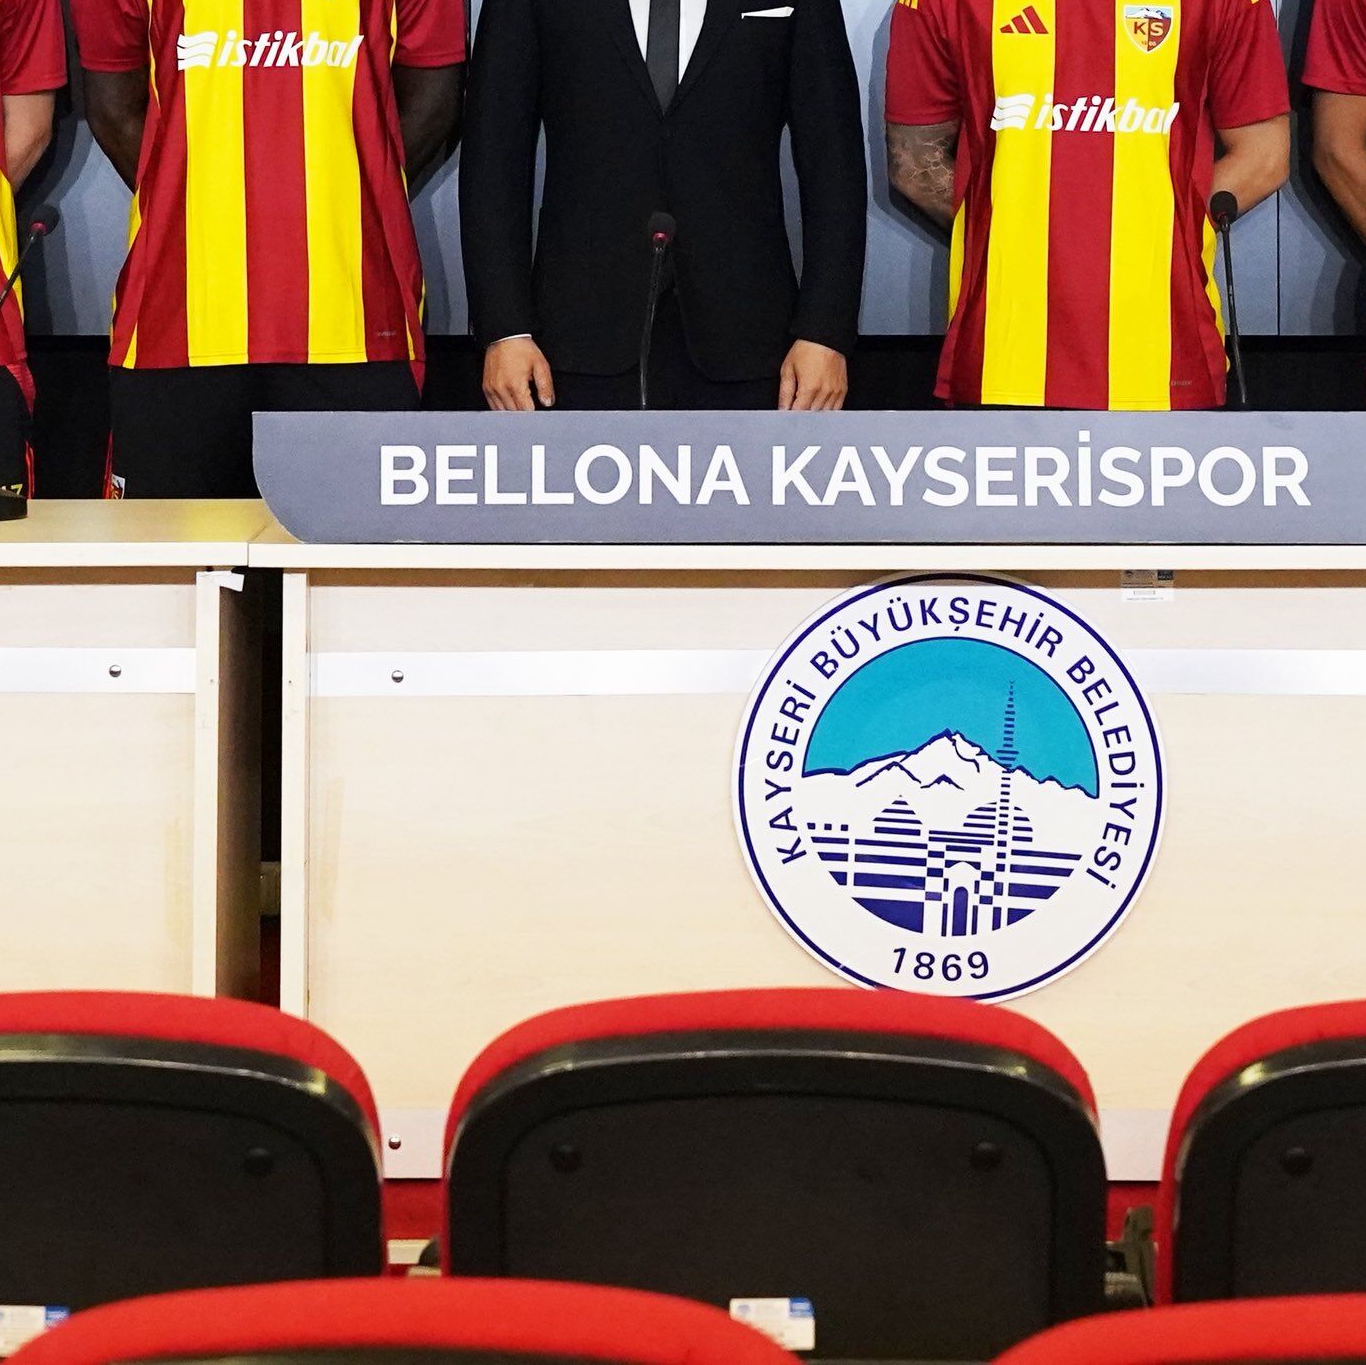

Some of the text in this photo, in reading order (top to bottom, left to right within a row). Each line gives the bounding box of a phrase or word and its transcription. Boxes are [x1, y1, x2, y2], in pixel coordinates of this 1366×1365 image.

[217, 30, 364, 67] istikbal
[1133, 21, 1164, 37] KS
[1033, 93, 1179, 134] istikbal
[380, 430, 1312, 507] BELLONA KAYSERİSPOR
[765, 596, 1145, 891] KAYSERİ BÜYÜKŞEHİR BELEDİYESİ
[892, 946, 989, 981] 1869
